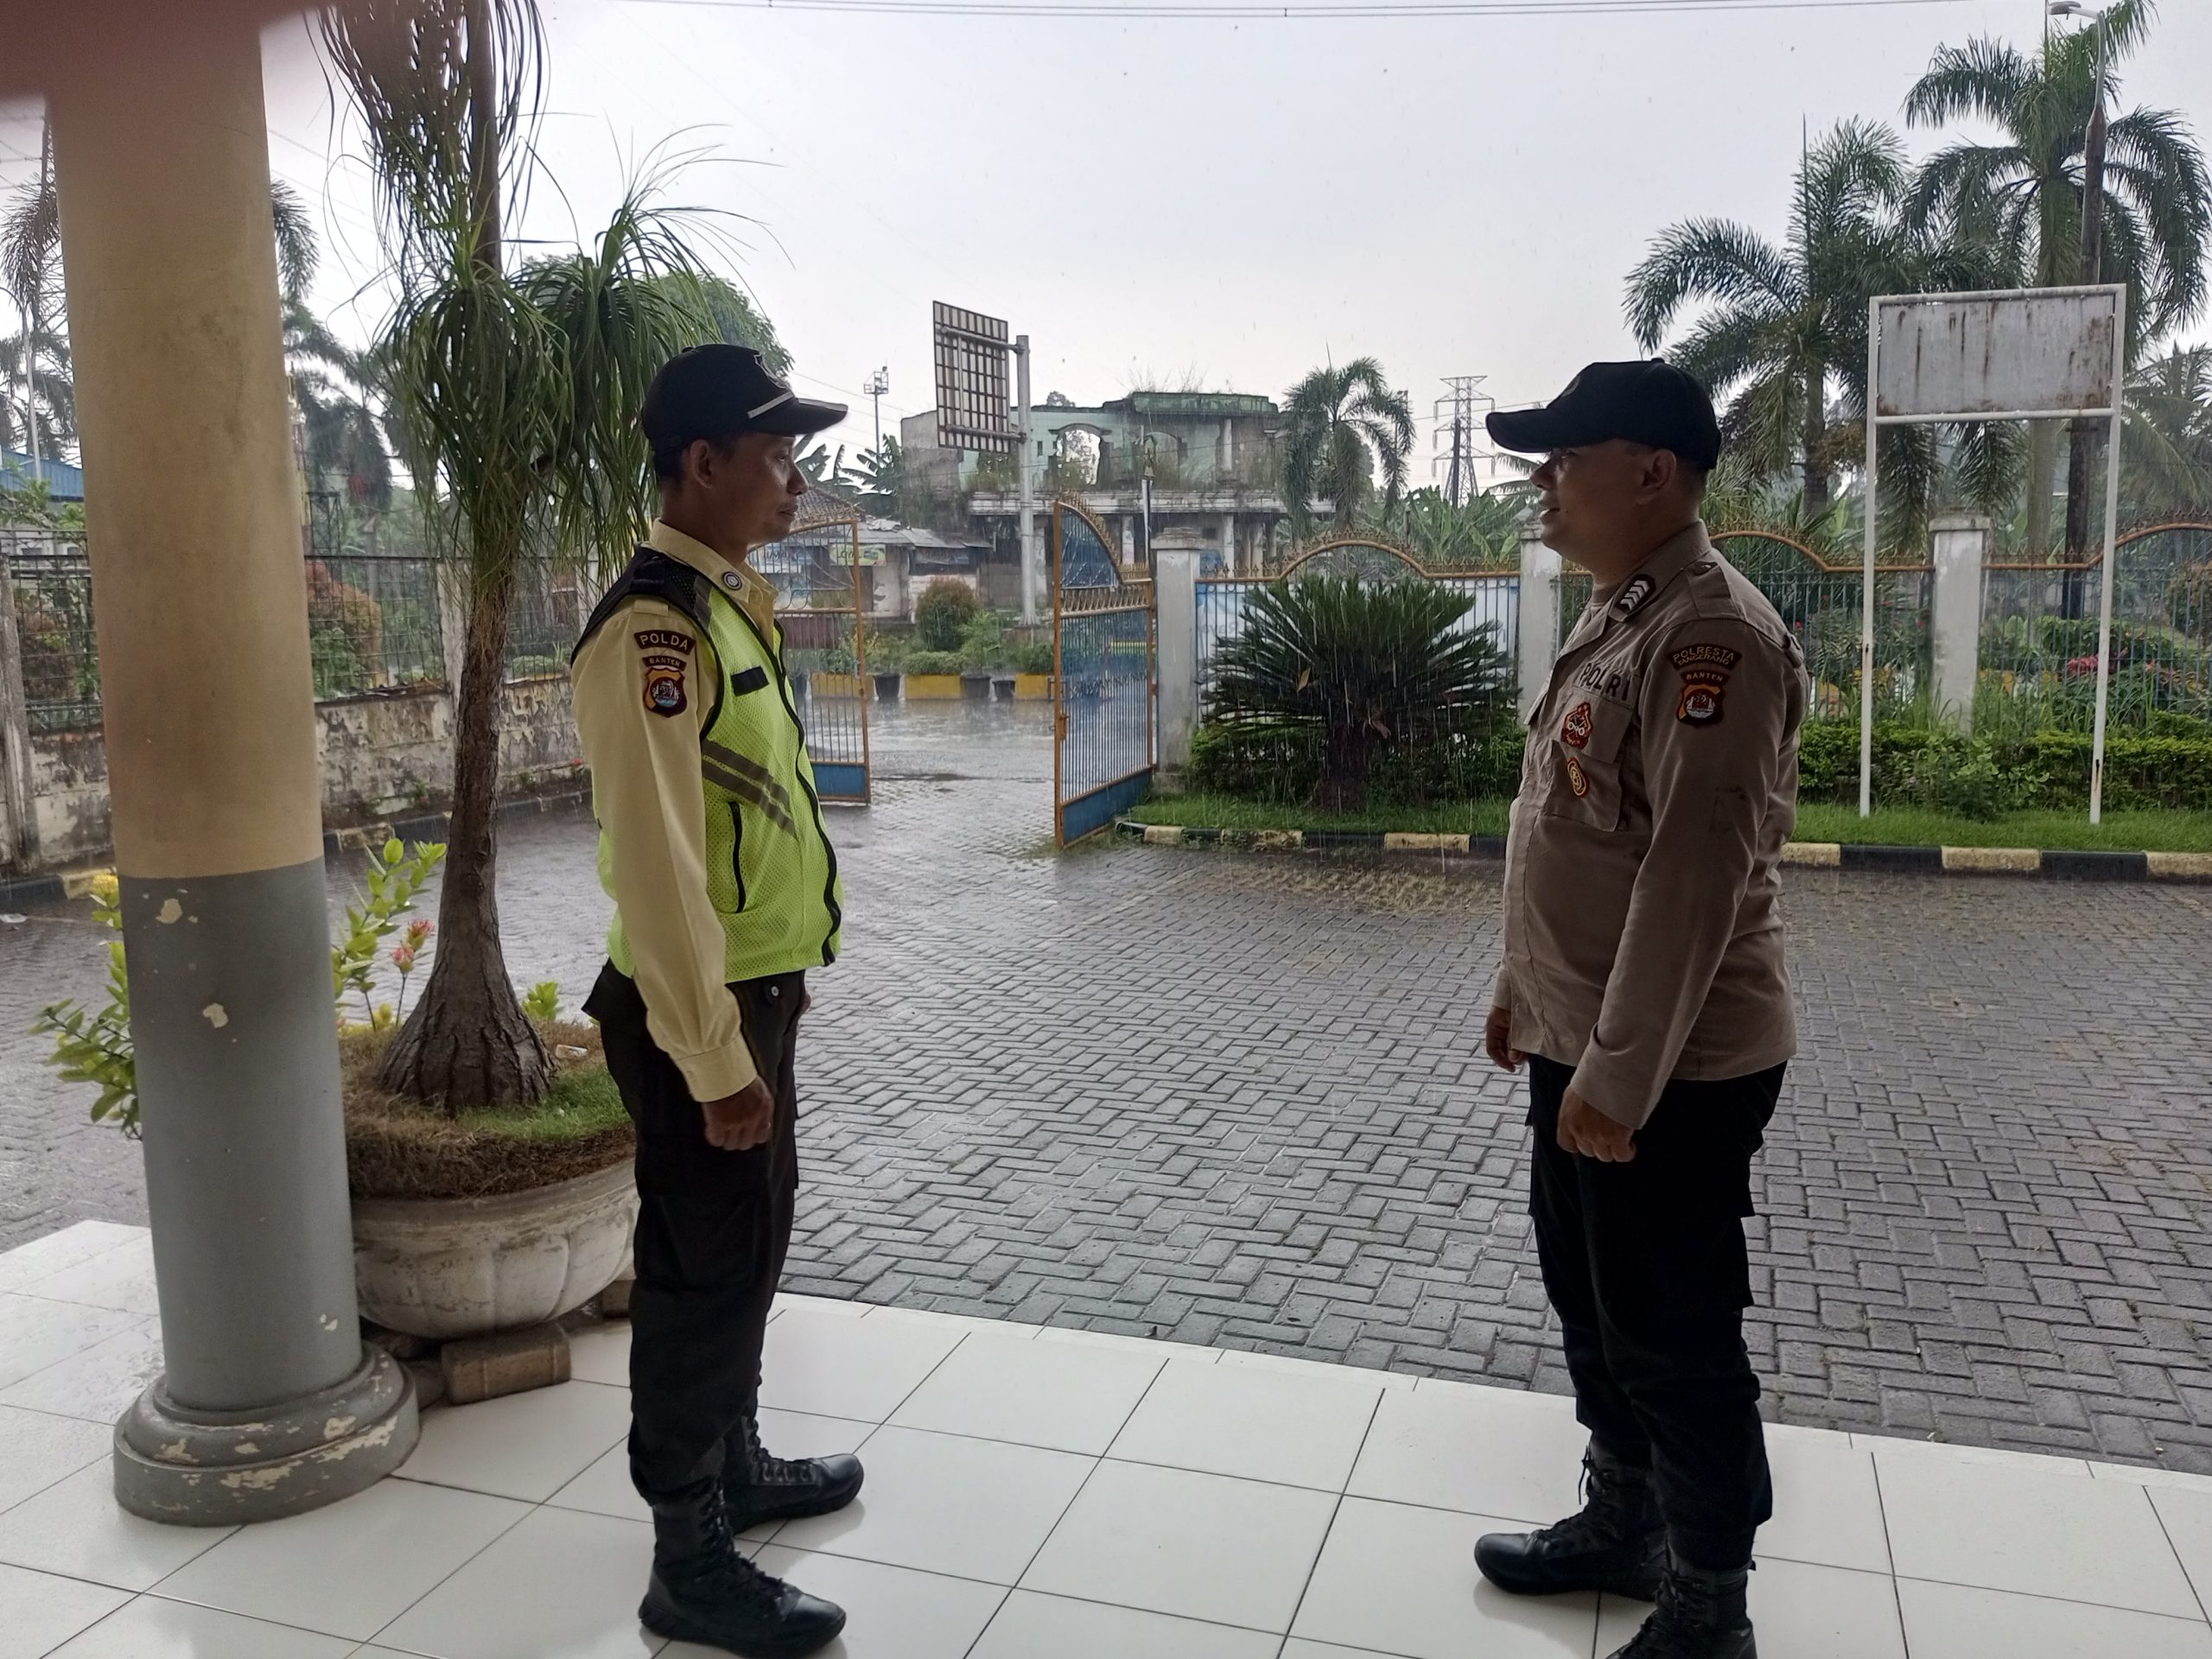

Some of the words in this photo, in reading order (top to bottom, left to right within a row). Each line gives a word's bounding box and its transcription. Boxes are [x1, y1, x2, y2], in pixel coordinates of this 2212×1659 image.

[639, 632, 689, 651] POLDA
[1673, 646, 1734, 663] POLRESTA
[1677, 653, 1730, 665] TANGERANG
[649, 657, 681, 667] BANTEN
[1580, 663, 1630, 701] POLRI
[1686, 672, 1724, 683] BANTEN
